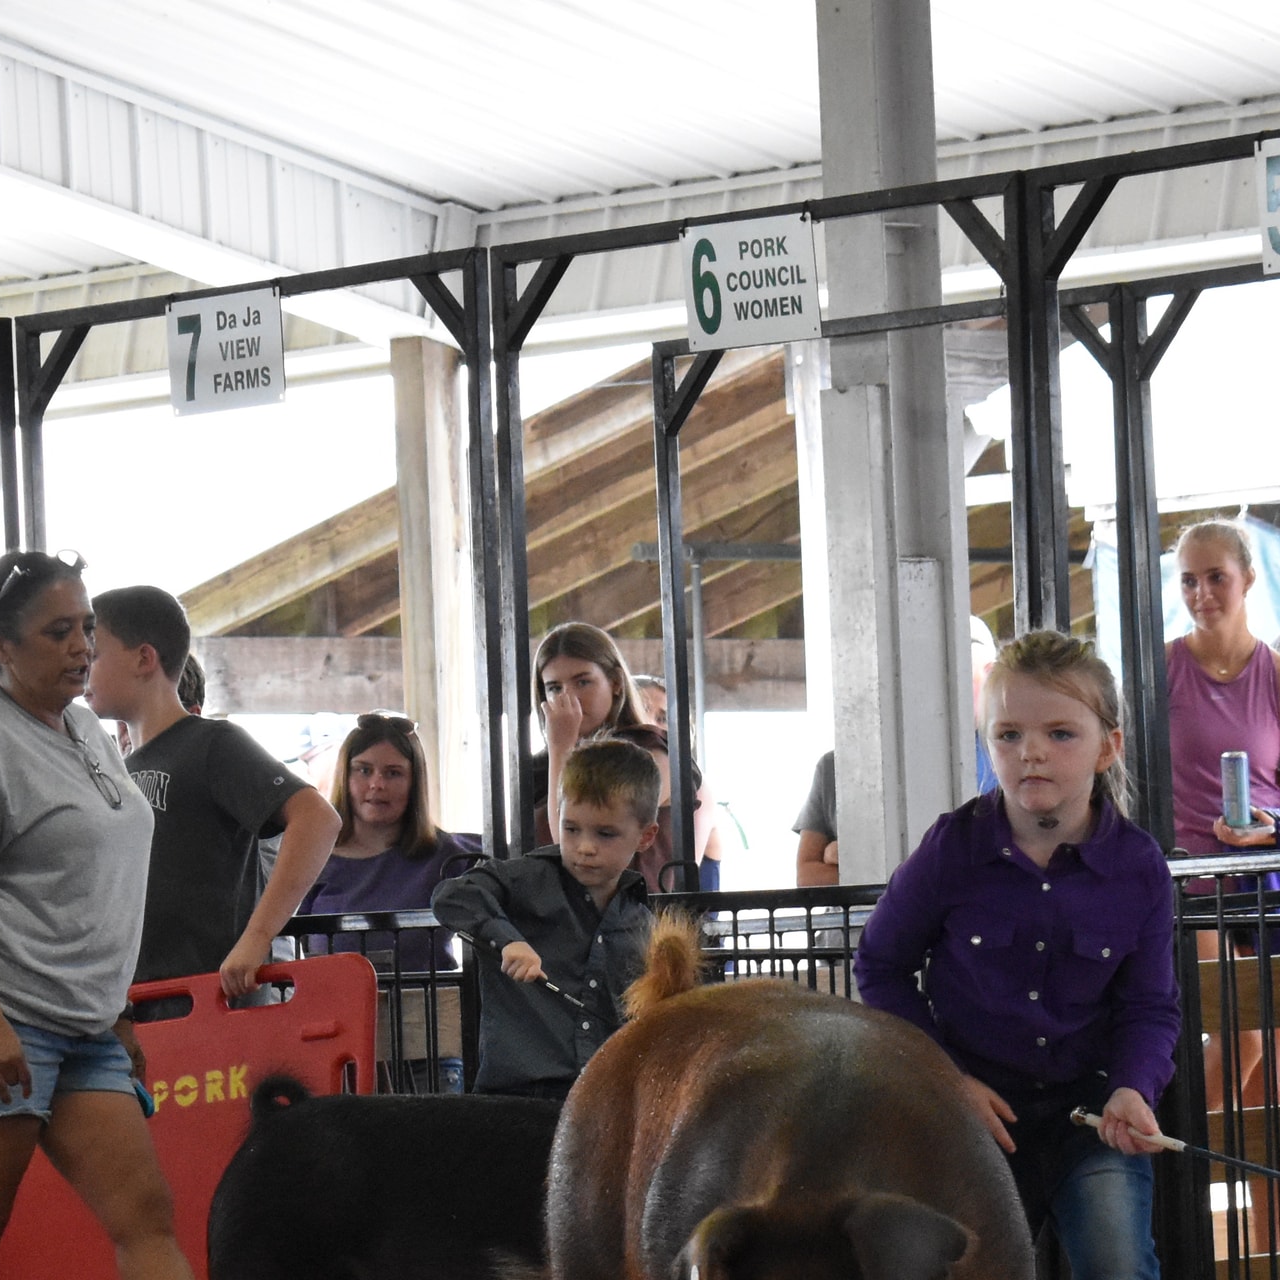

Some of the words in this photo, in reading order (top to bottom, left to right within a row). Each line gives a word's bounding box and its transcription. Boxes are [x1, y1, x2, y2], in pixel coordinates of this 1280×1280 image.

[738, 235, 789, 260] PORK
[691, 238, 722, 335] 6
[726, 264, 807, 292] COUNCIL
[216, 310, 237, 331] Da
[242, 306, 261, 327] Ja
[733, 295, 803, 321] WOMEN
[177, 313, 201, 402] 7
[218, 336, 261, 362] VIEW
[213, 366, 272, 394] FARMS
[153, 1063, 249, 1113] PORK
